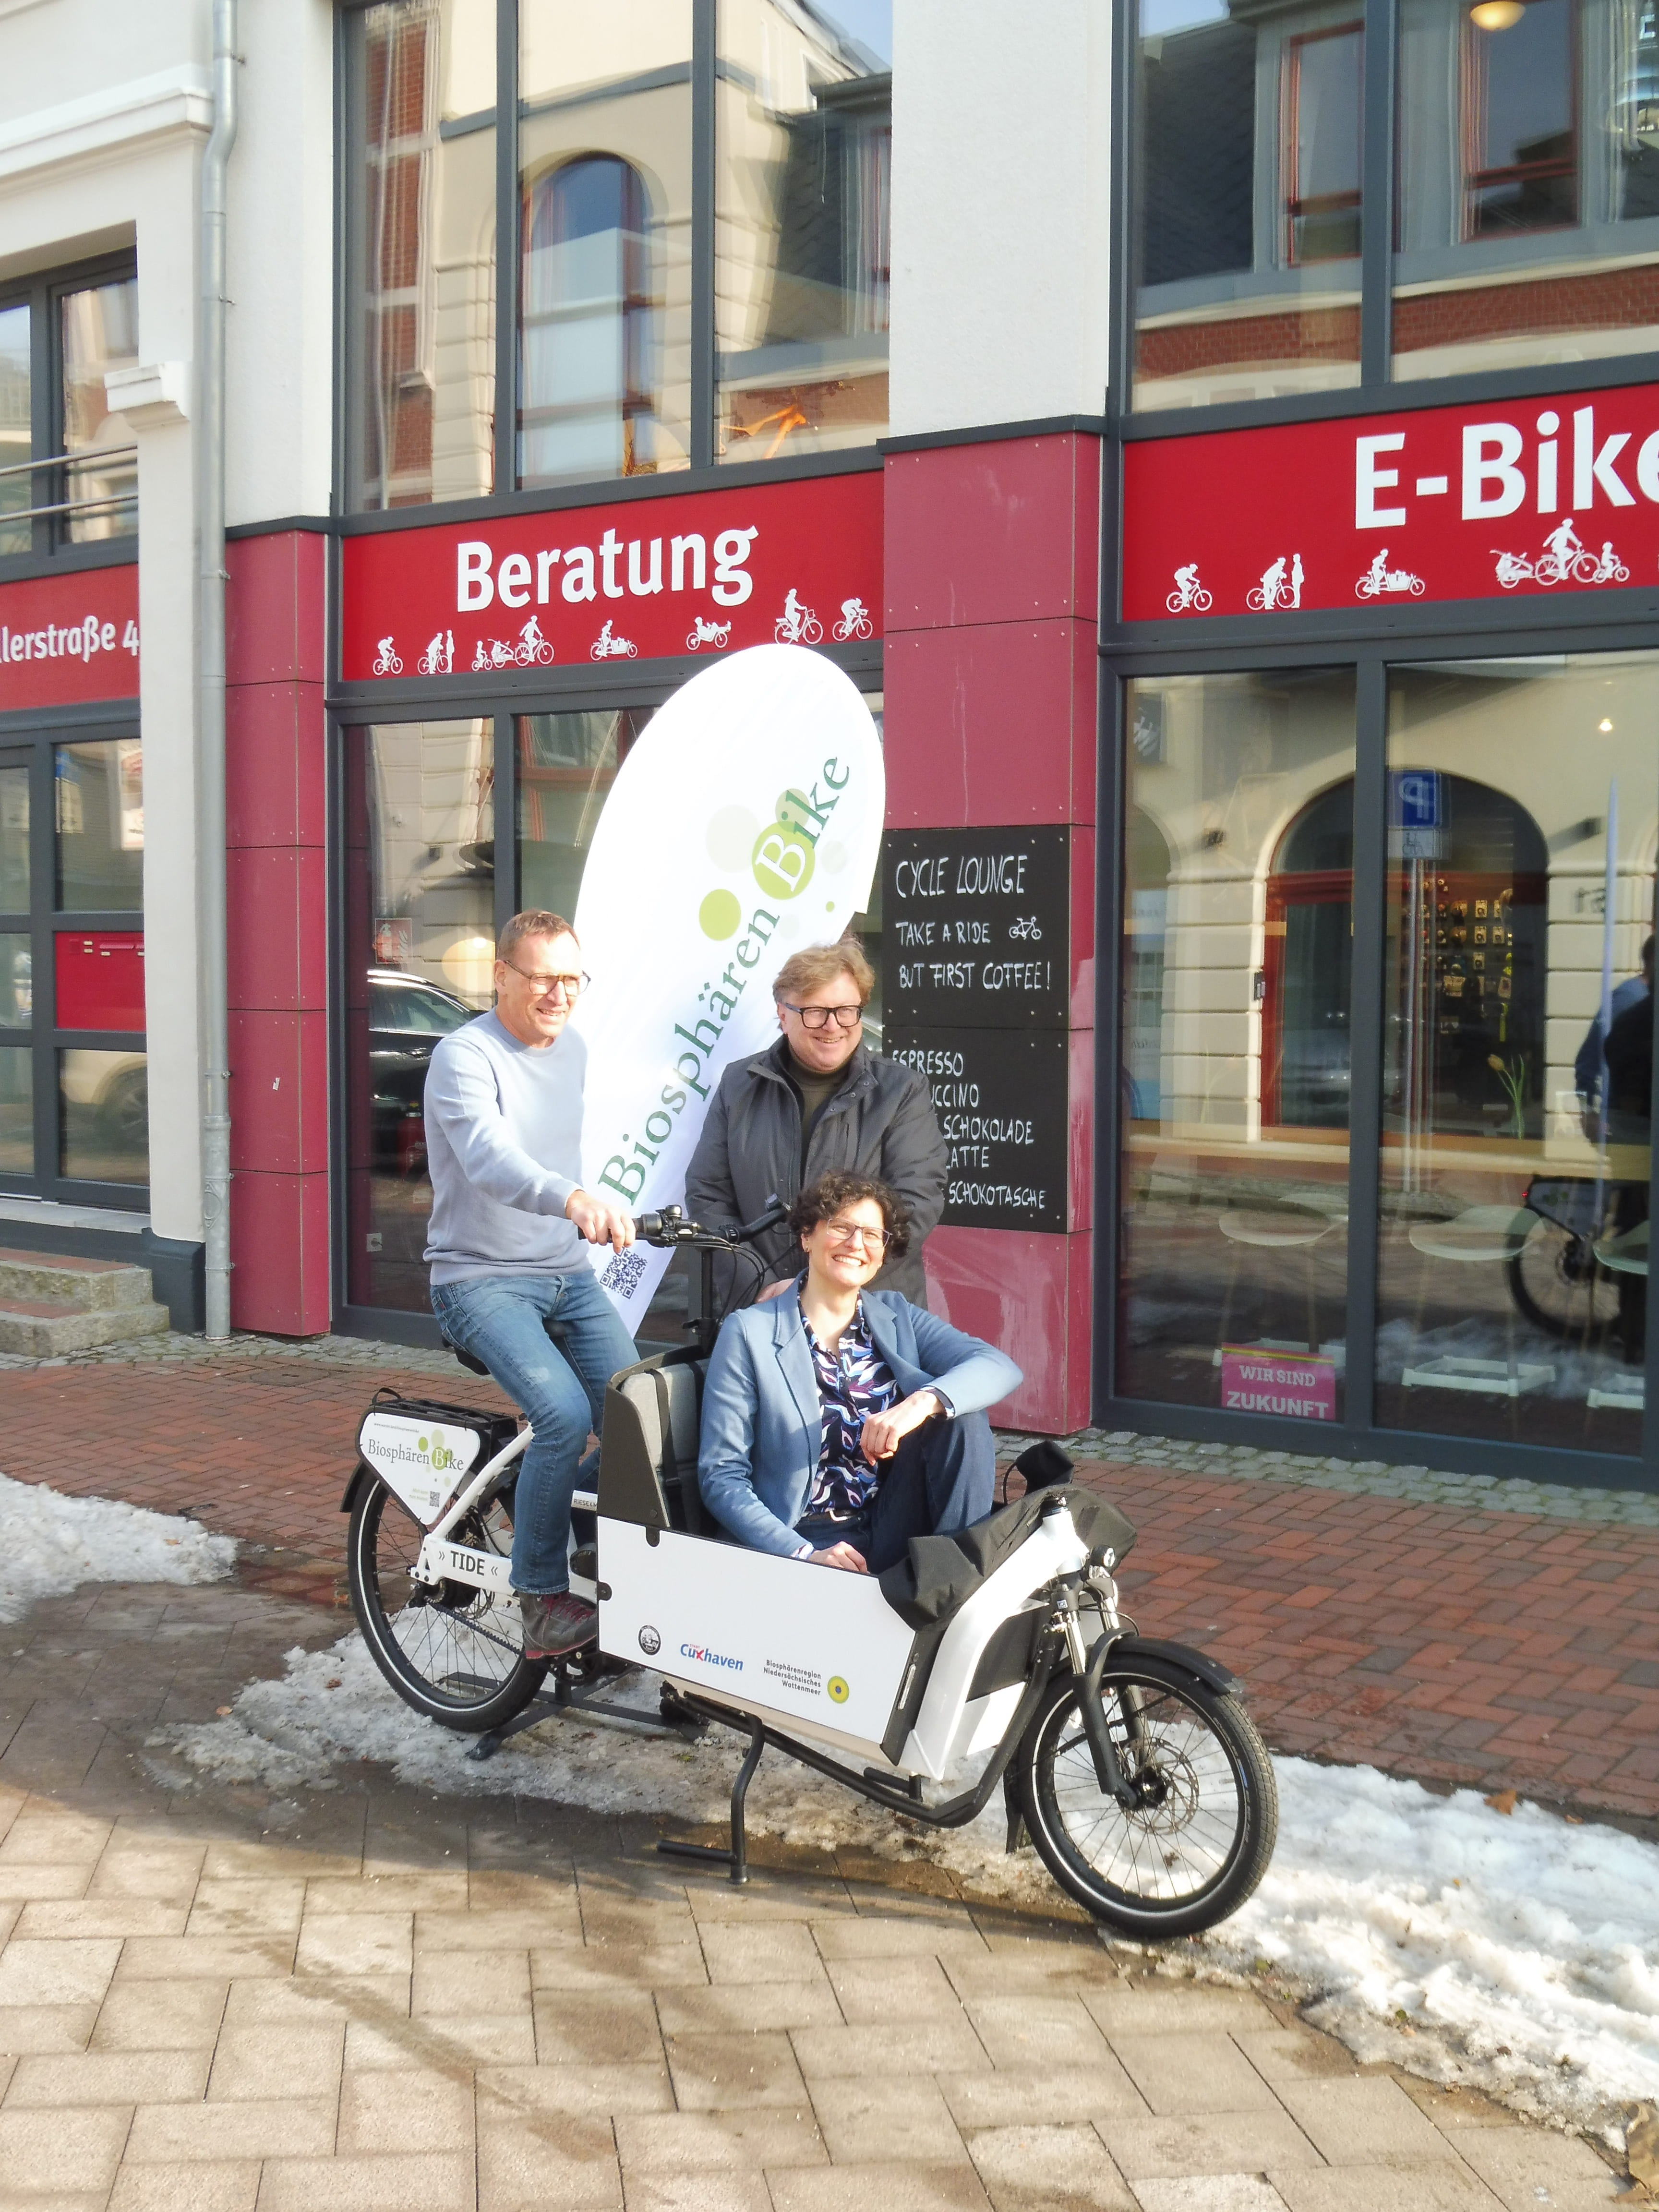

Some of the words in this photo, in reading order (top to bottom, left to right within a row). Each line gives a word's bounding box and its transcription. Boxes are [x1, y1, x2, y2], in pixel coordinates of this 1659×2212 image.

[457, 525, 758, 613] Beratung
[0, 615, 116, 663] lerstraße
[896, 857, 950, 898] CYCLE
[956, 854, 1028, 894] LOUNGE
[895, 921, 936, 947] TAKE
[943, 924, 951, 942] A
[955, 921, 991, 944] RIDE
[899, 962, 925, 988] BUT
[929, 962, 975, 988] FIRST
[944, 1114, 1034, 1144] SCHOKOLADE
[946, 1145, 990, 1170] ATTE
[949, 1181, 1047, 1209] SCHOKOTASCHE
[1239, 1365, 1274, 1382] WIR
[1276, 1370, 1316, 1387] SIND
[1227, 1391, 1329, 1419] ZUKUNFT
[451, 1550, 485, 1576] TIDE
[680, 1643, 744, 1671] Cuxhaven
[766, 1659, 821, 1680] Biosphärenregion
[764, 1667, 821, 1688] Niedersächsisches
[782, 1680, 821, 1695] Wattenmeer
